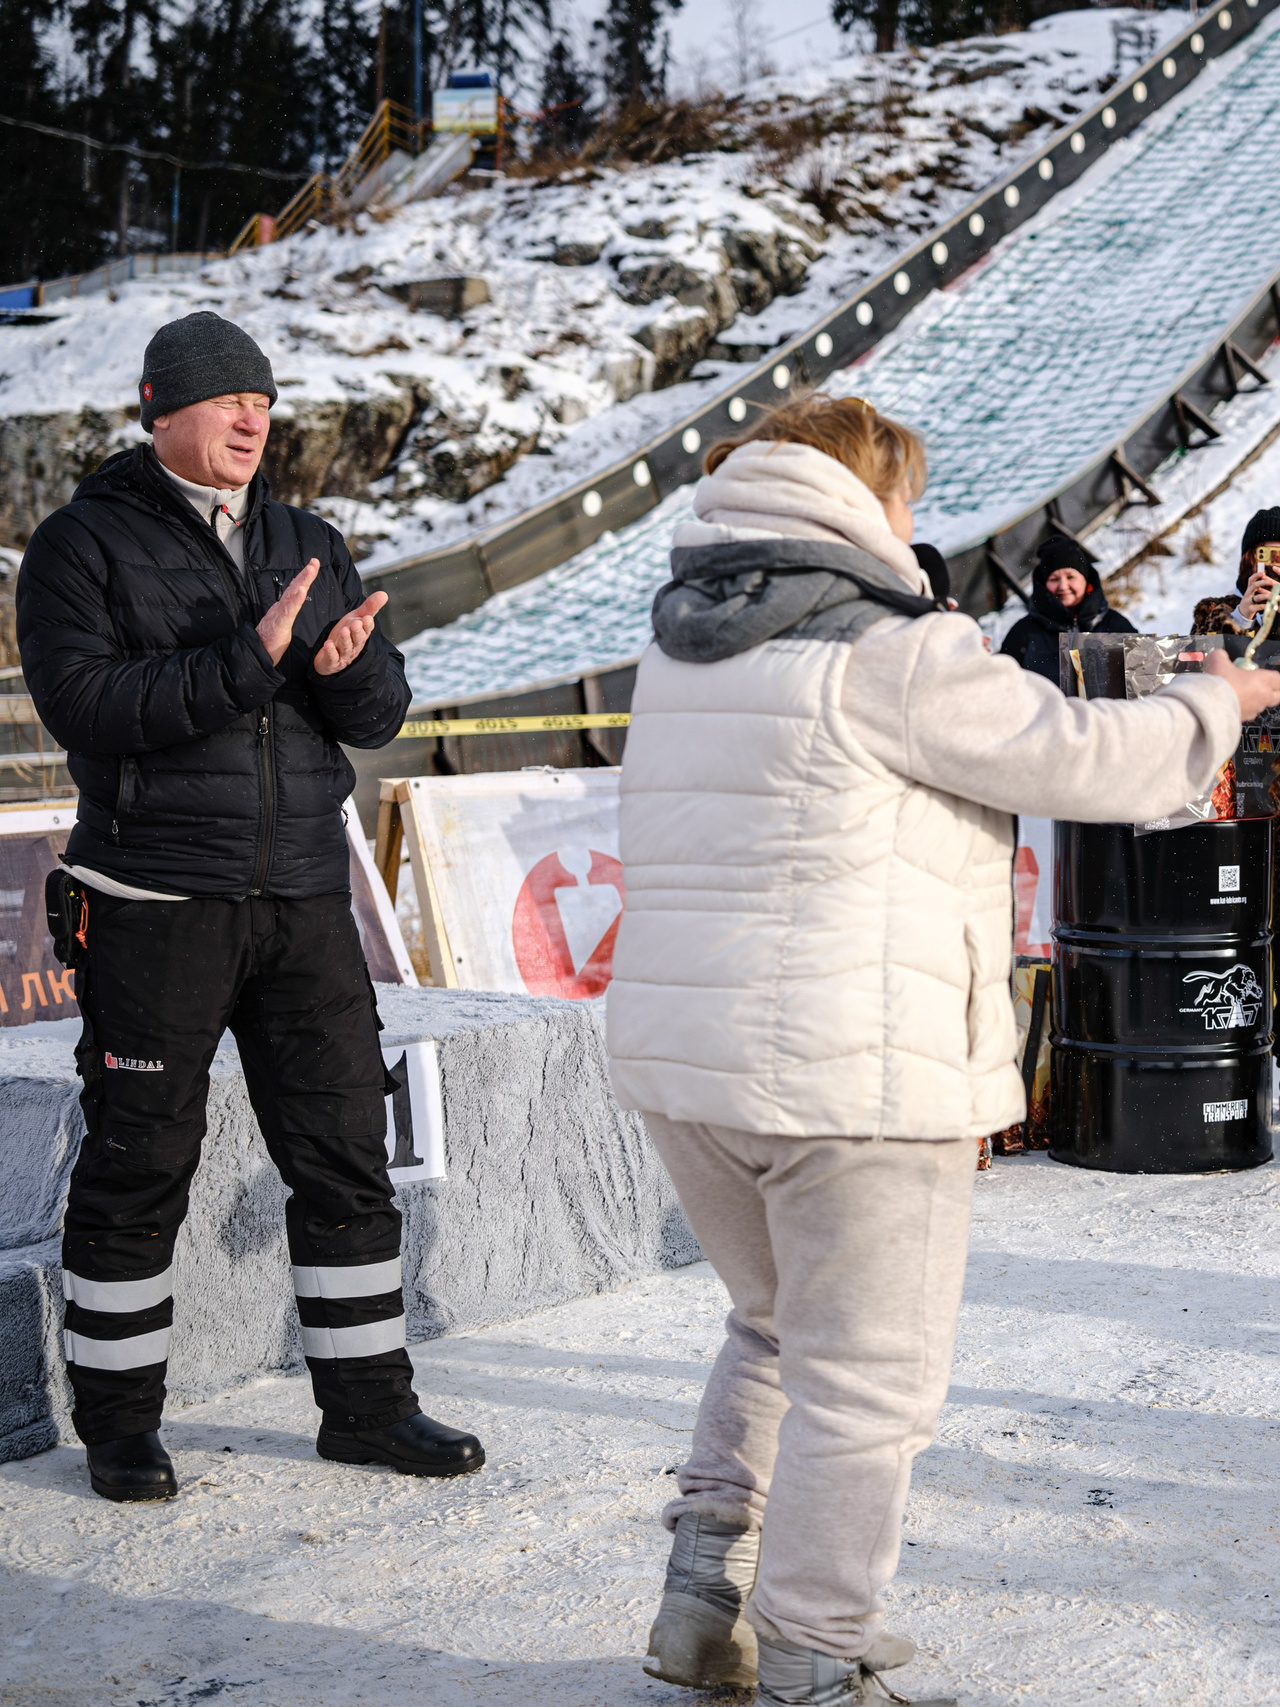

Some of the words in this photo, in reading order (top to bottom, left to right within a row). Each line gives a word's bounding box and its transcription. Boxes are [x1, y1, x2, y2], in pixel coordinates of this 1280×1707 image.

[407, 721, 449, 735] STOP
[475, 718, 517, 731] STOP
[543, 716, 583, 729] STOP
[118, 1057, 164, 1069] LINDAL
[386, 1049, 424, 1170] 1
[1203, 1099, 1248, 1114] COMMERCIAL
[1204, 1109, 1248, 1123] TRANSPORT
